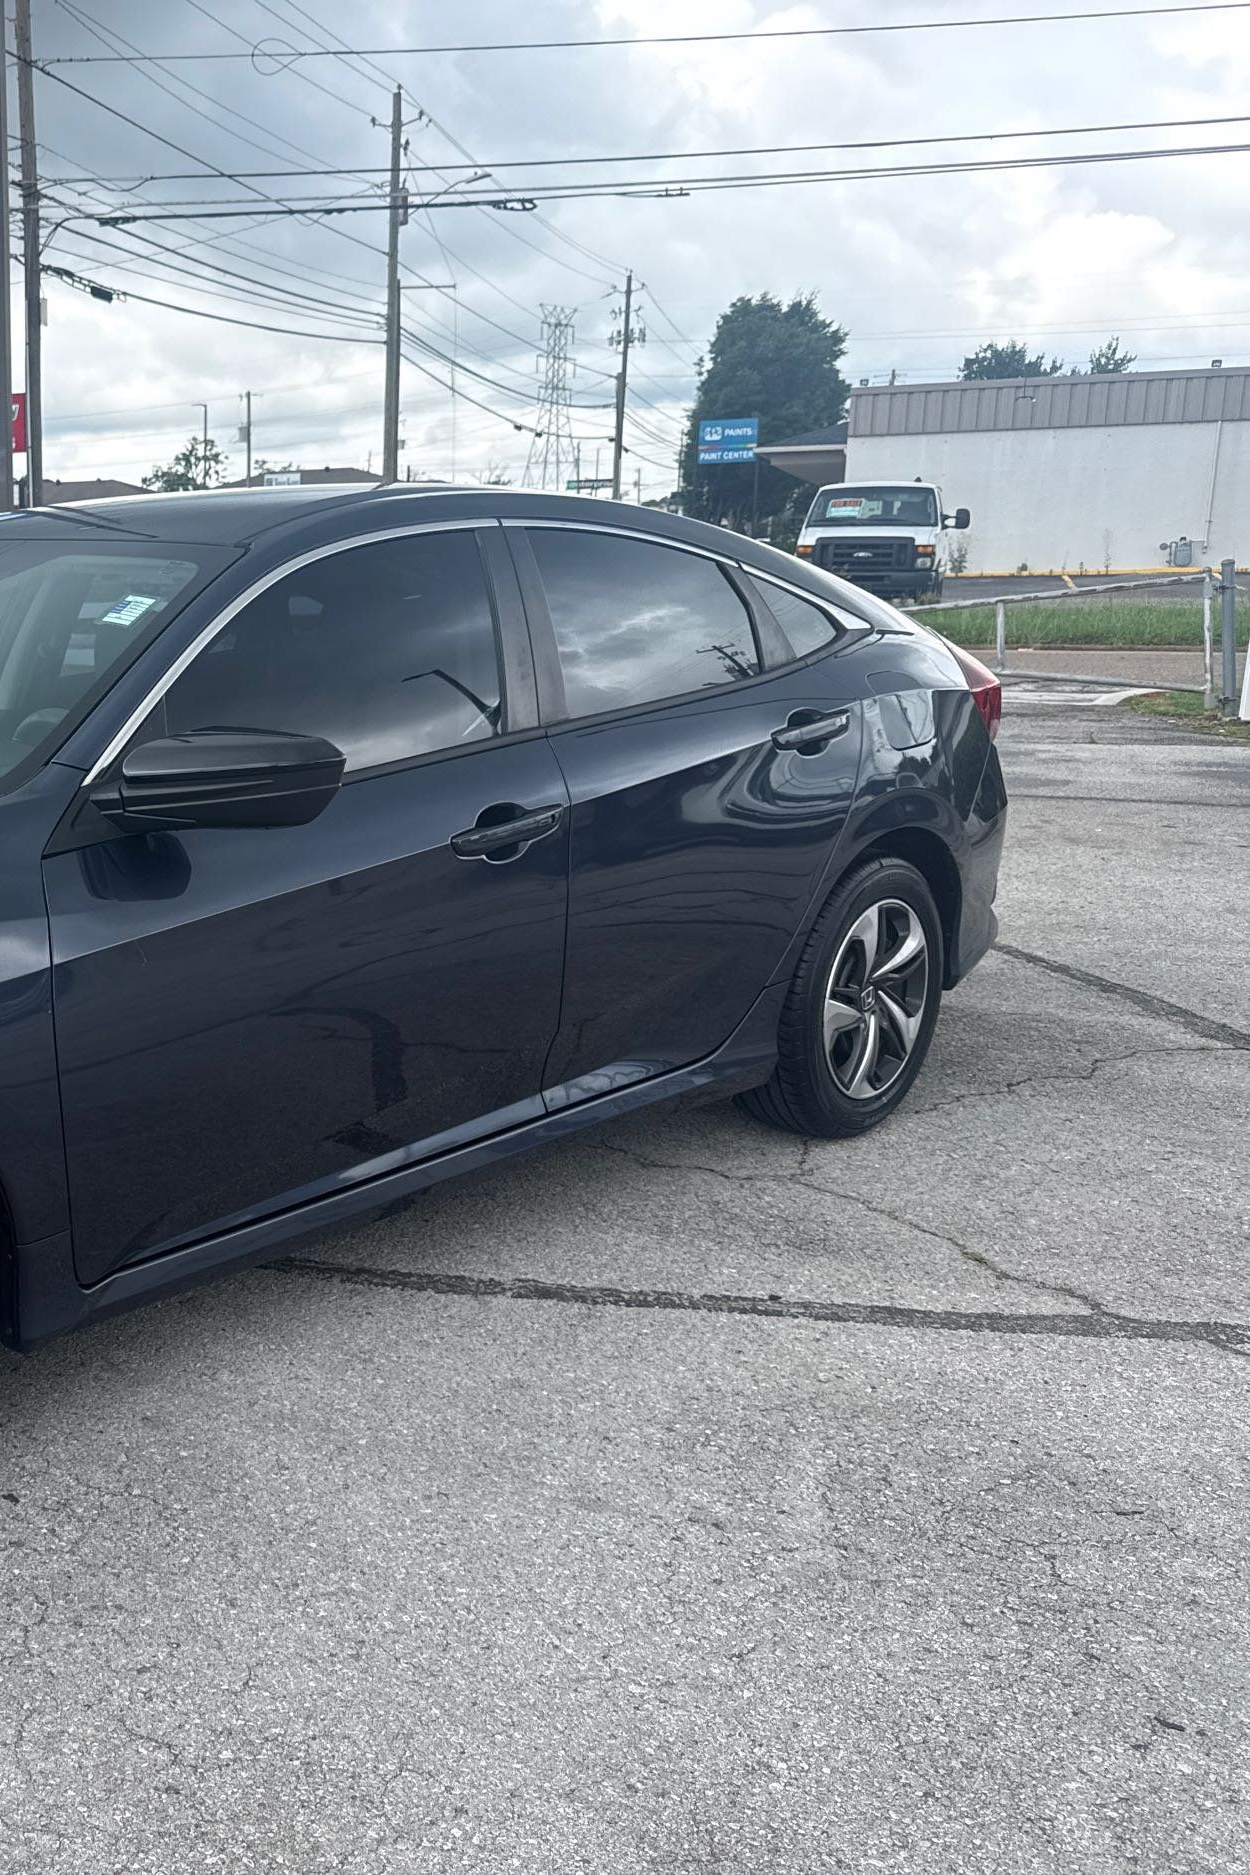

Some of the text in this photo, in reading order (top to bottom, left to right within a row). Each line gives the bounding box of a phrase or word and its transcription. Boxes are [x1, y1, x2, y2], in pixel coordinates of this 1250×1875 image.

[724, 427, 752, 437] PAINTS
[699, 450, 754, 461] PAINT CENTER
